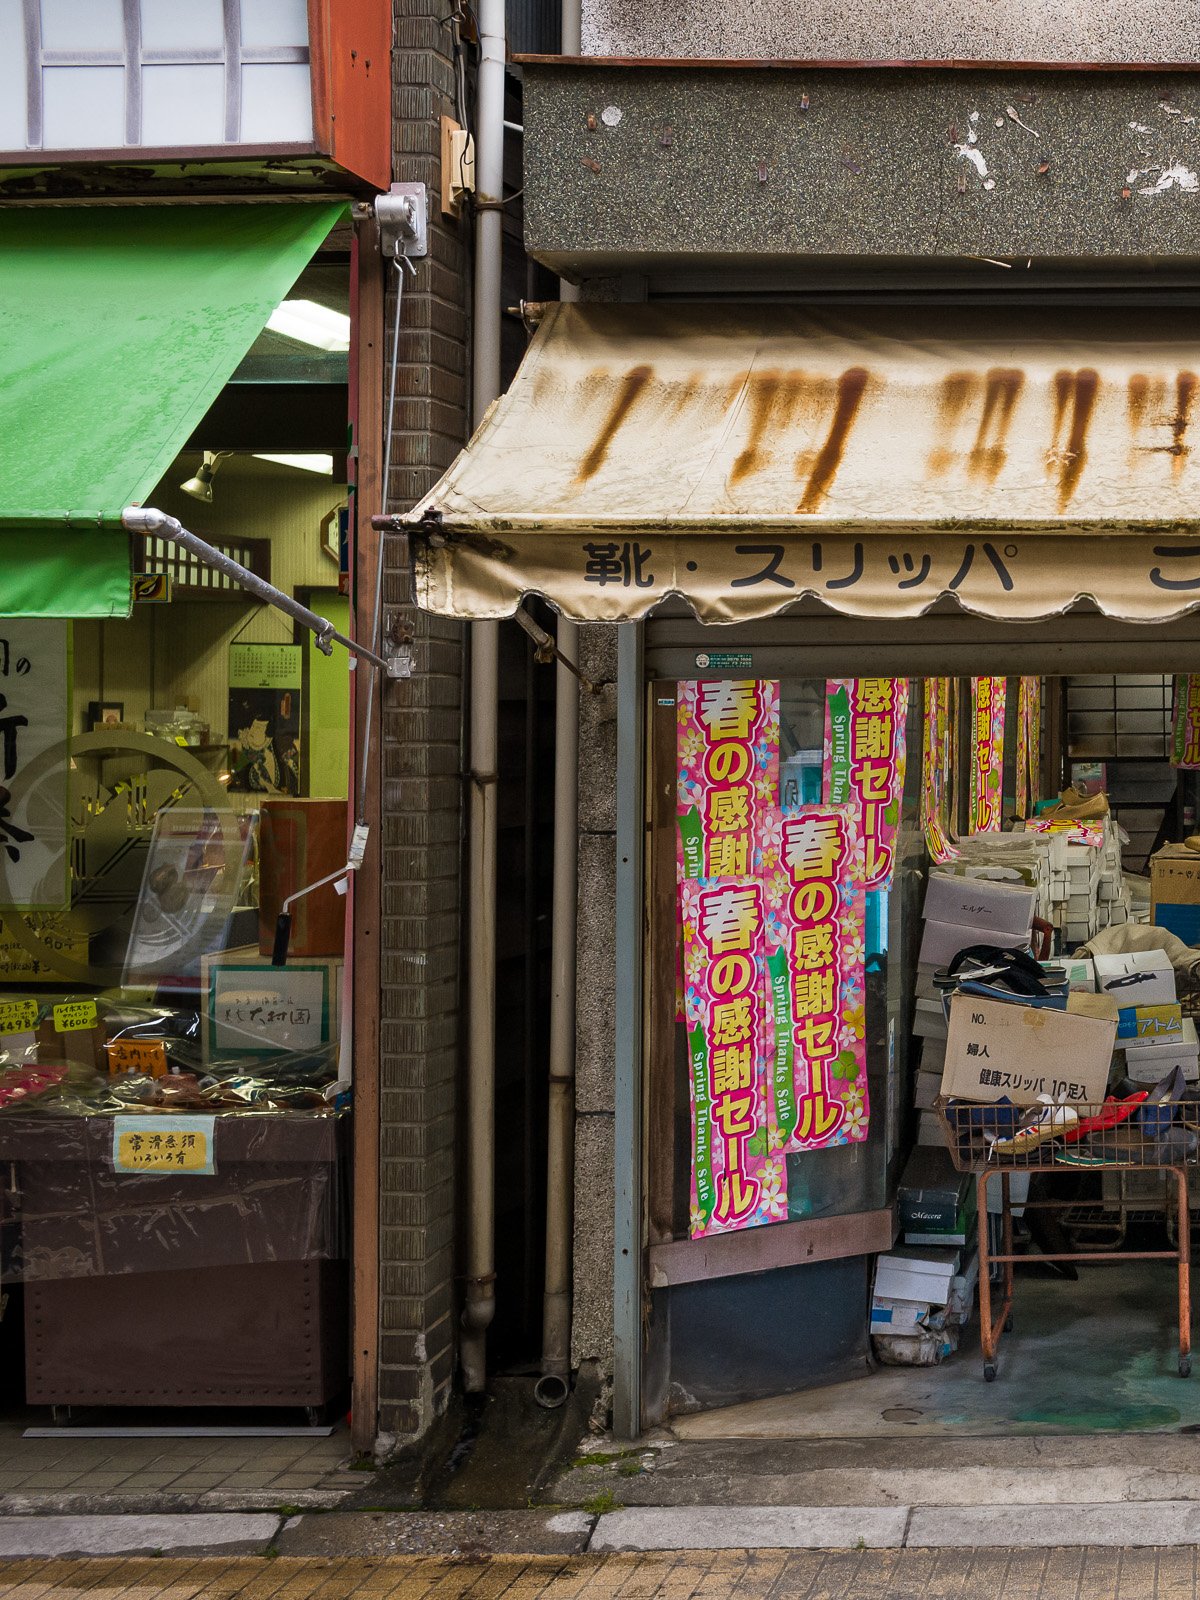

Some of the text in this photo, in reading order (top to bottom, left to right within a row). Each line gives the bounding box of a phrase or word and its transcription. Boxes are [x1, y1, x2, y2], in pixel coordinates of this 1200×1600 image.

[582, 541, 1019, 592] 靴・スリッパ
[833, 715, 847, 762] Spring
[701, 679, 759, 877] 春の感謝
[784, 818, 844, 1140] 春の感謝セール
[61, 1018, 88, 1029] ¥600
[971, 1012, 987, 1025] NO.
[1137, 1016, 1183, 1035] アトム
[702, 890, 759, 1219] 春の感謝セール
[773, 975, 790, 1122] Spring Thanks Sale
[966, 1043, 990, 1058] 婦人
[979, 1068, 1046, 1093] 健康スリッパ
[692, 1051, 709, 1201] Spring Thanks Sale
